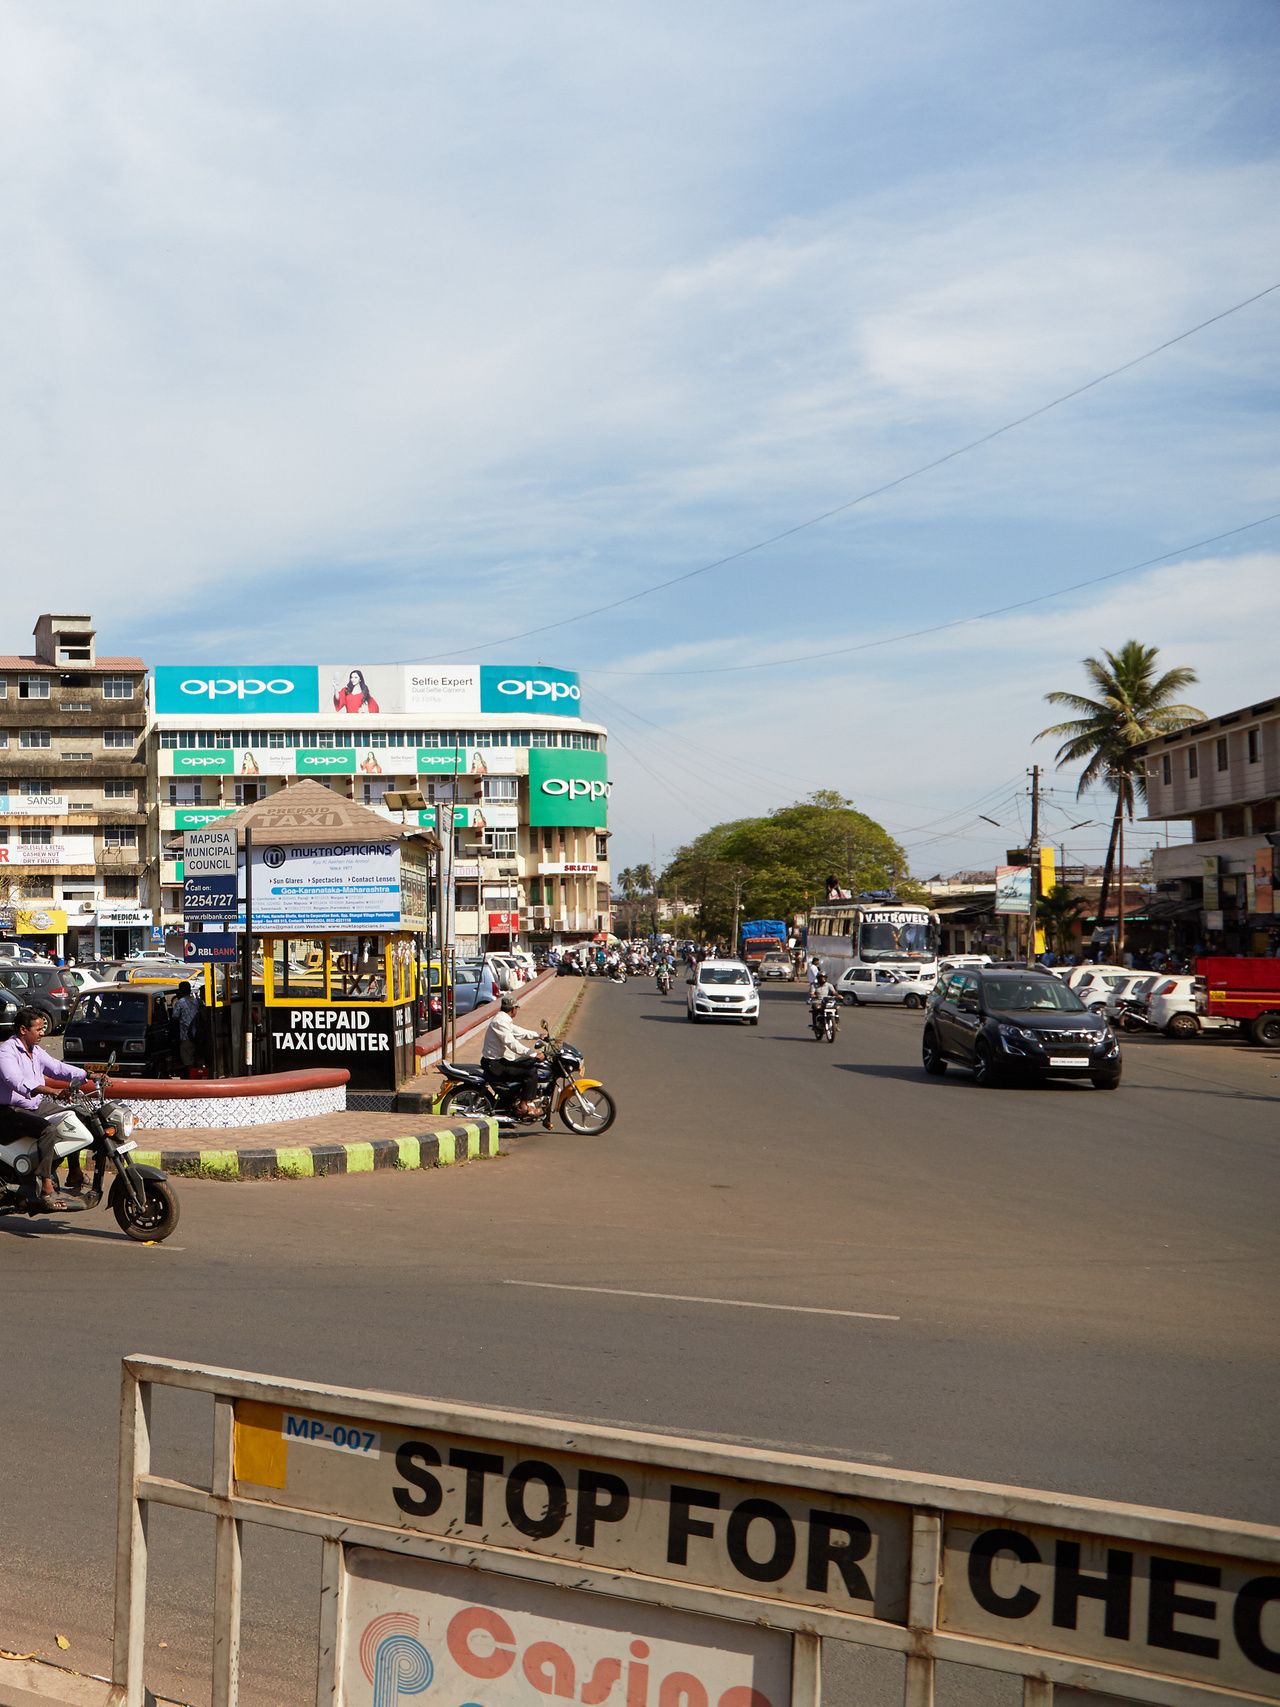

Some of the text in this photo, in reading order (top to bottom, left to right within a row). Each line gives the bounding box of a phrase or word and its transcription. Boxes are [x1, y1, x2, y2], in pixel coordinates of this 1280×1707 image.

[412, 677, 473, 687] Selfie Expert
[27, 796, 63, 805] SANSUI
[257, 814, 334, 827] TAXI
[190, 834, 230, 844] MAPUSA
[185, 846, 235, 857] MUNICIPAL
[189, 860, 230, 869] COUNCIL
[184, 894, 233, 907] 2254727
[290, 1011, 370, 1029] PREPAID
[272, 1032, 313, 1050] TAXI
[316, 1033, 389, 1051] COUNTER
[286, 1416, 376, 1453] MP-007
[392, 1440, 1280, 1674] STOP FOR CHEC
